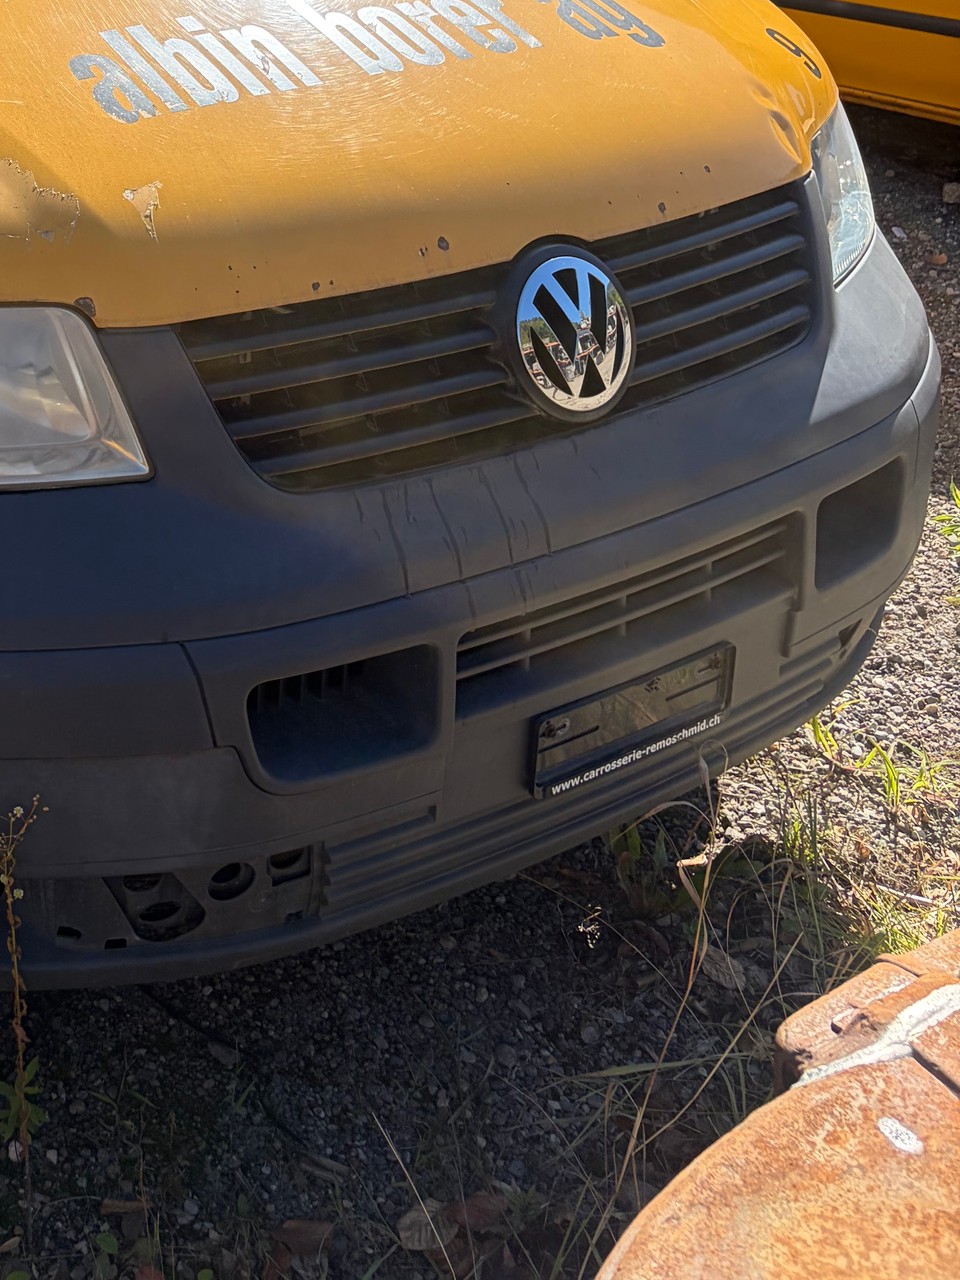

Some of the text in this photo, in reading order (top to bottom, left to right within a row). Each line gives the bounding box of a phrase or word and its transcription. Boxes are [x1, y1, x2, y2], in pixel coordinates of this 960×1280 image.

[69, 15, 323, 125] albin
[765, 27, 822, 79] 9
[551, 714, 722, 796] www.carrosserie-remoschmid.ch
